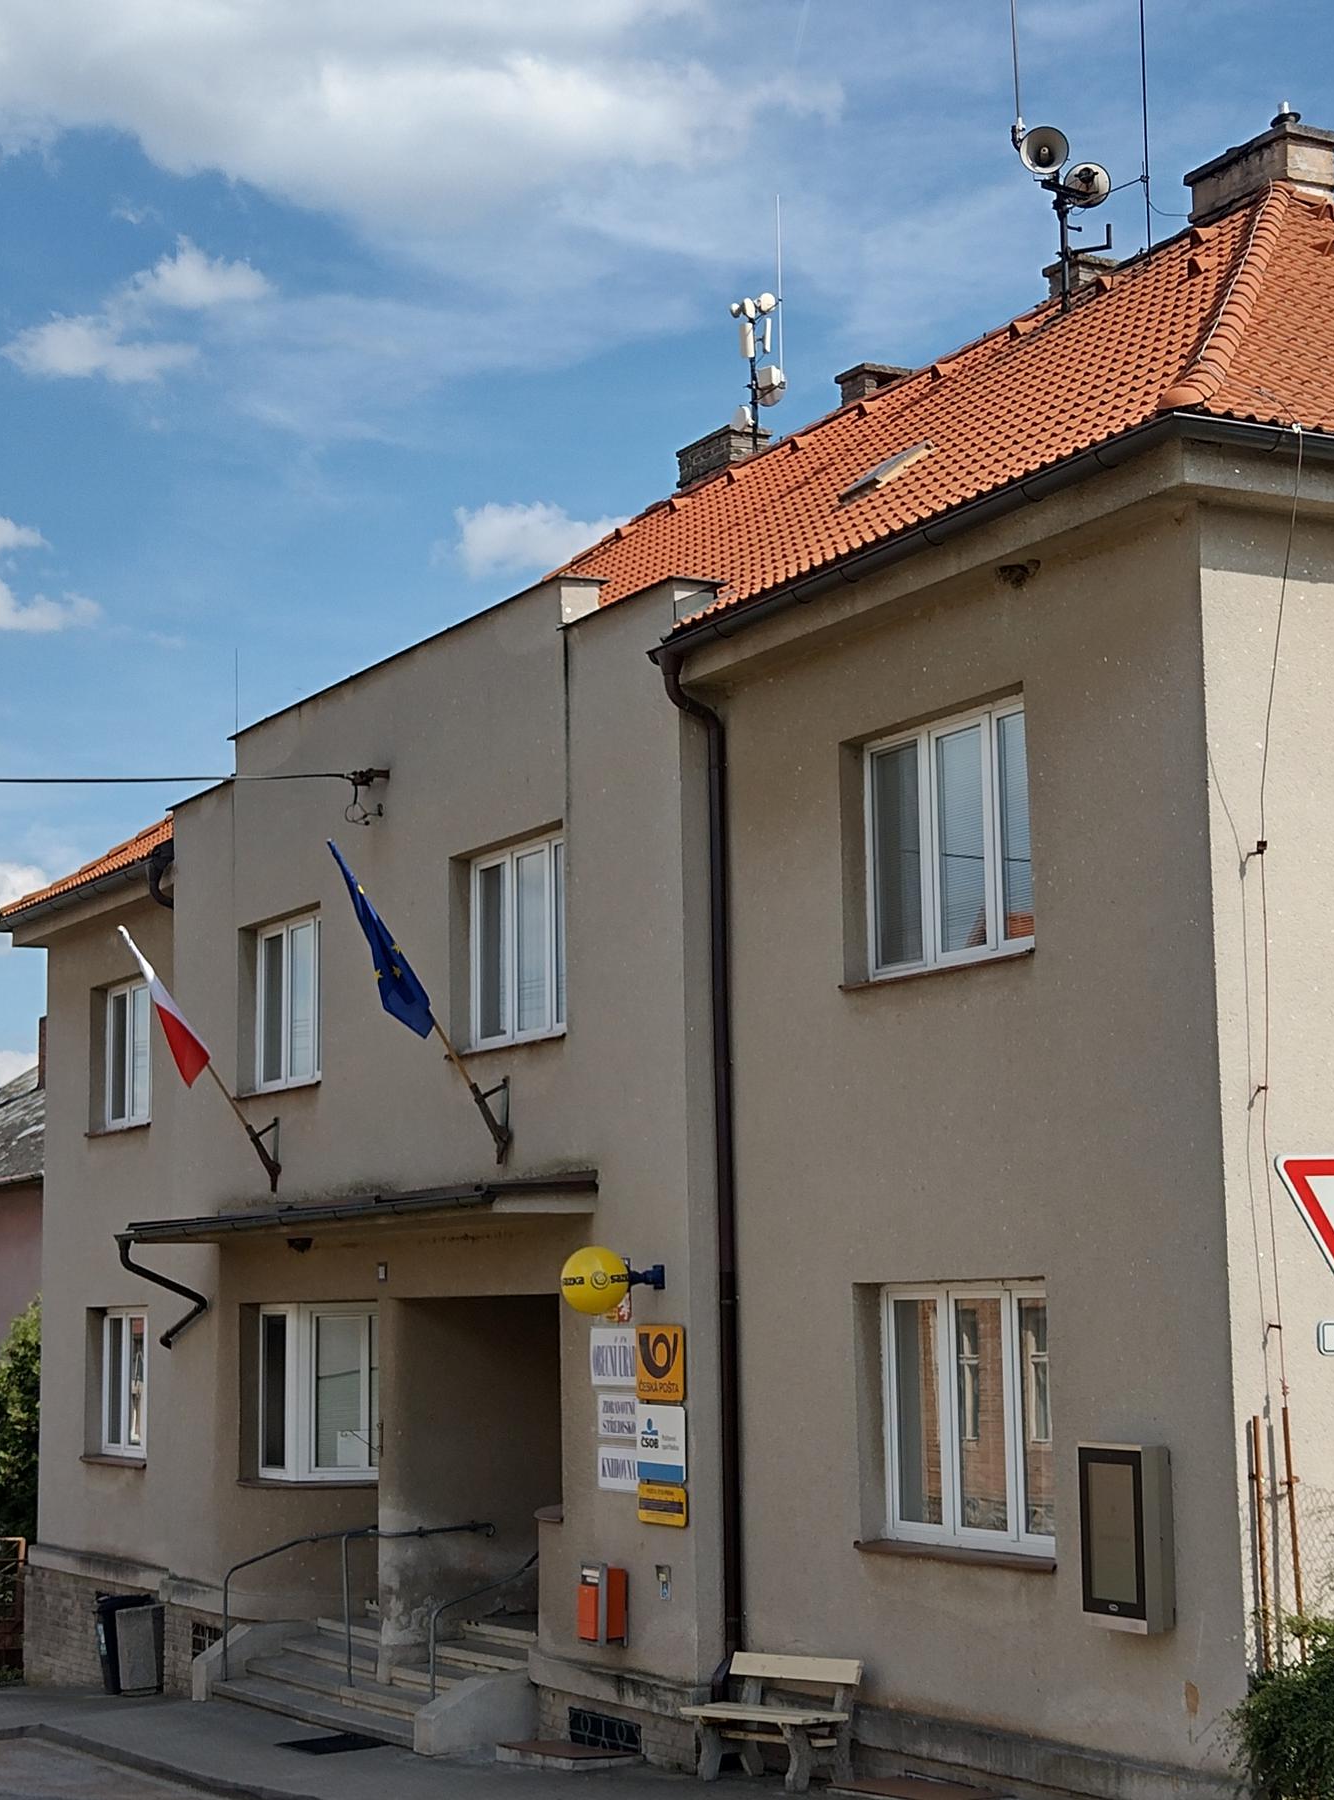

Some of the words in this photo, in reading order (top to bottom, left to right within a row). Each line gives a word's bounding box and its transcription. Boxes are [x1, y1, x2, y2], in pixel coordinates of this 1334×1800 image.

[639, 1380, 658, 1393] ČESKÁ
[659, 1380, 679, 1393] POŠTA
[641, 1436, 659, 1449] ČSOB
